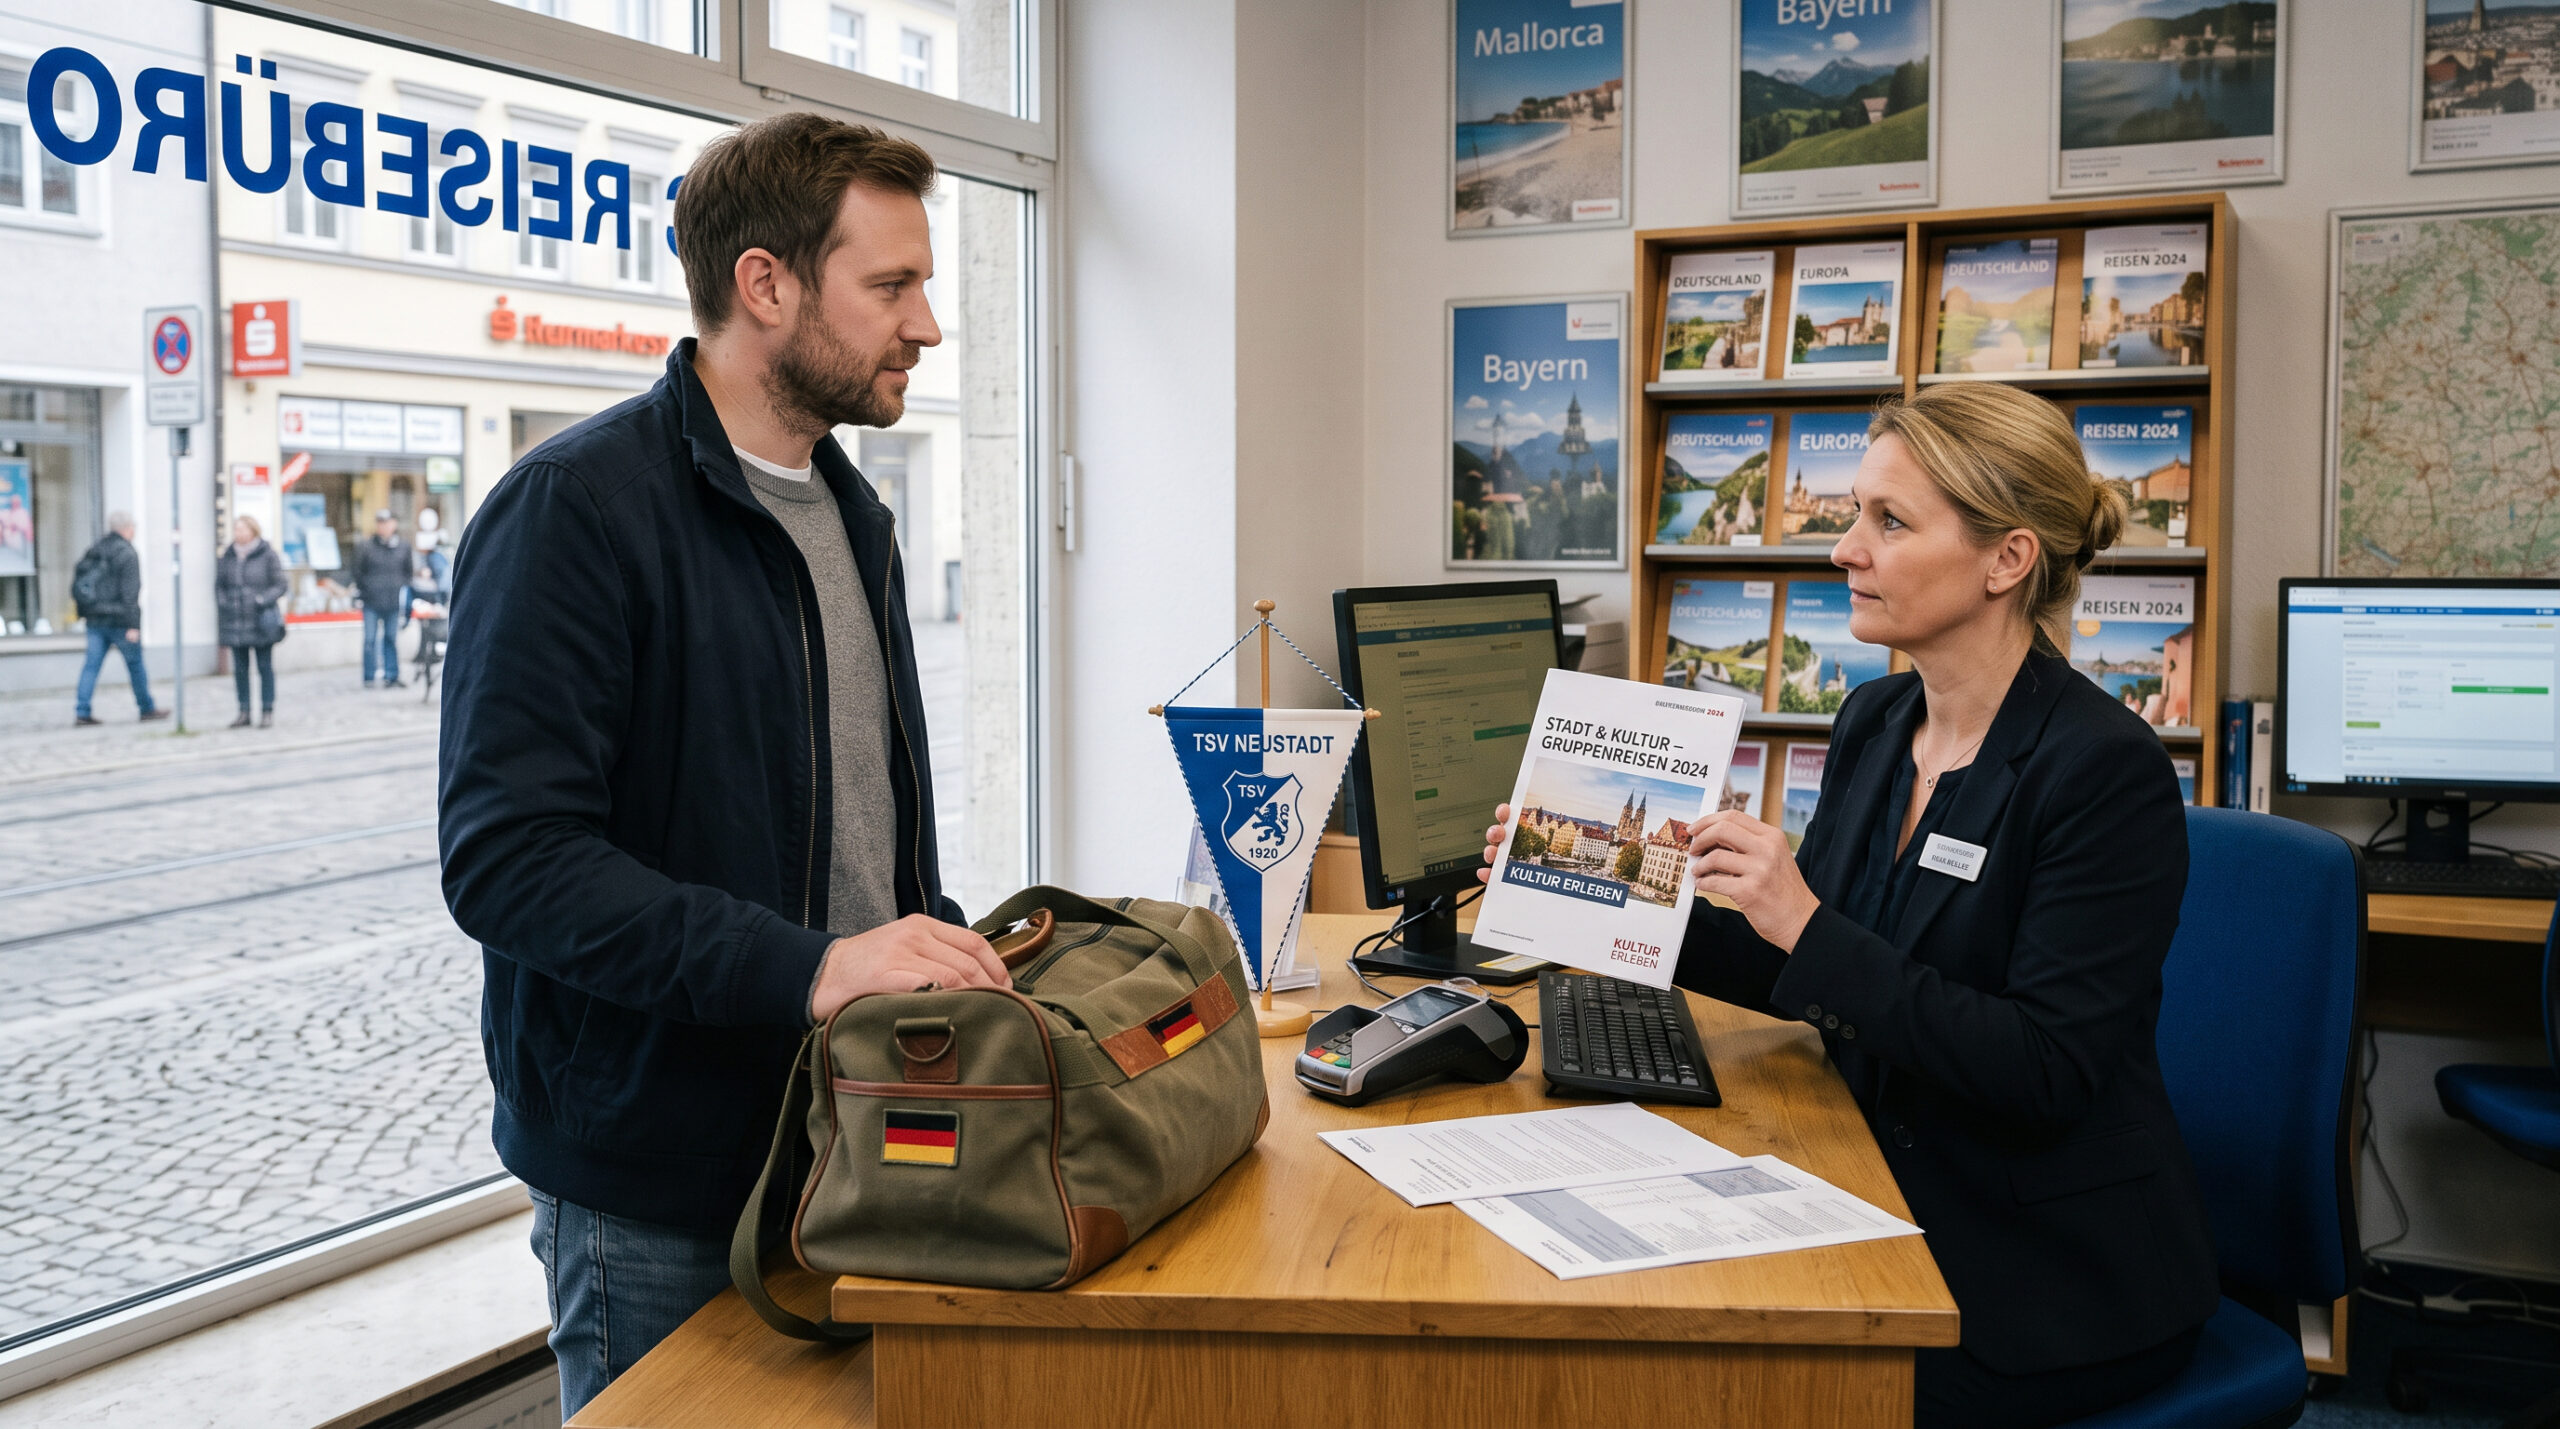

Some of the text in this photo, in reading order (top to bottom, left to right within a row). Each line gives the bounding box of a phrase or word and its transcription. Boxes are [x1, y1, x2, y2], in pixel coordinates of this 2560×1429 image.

[1474, 23, 1605, 58] Mallorca
[1950, 260, 2049, 276] DEUTSCHLAND
[2104, 253, 2187, 268] REISEN 2024
[1674, 274, 1762, 288] DEUTSCHLAND
[1800, 267, 1849, 280] EUROPA
[1482, 353, 1588, 390] Bayern
[2083, 424, 2179, 439] REISEN 2024
[1671, 433, 1764, 447] DEUTSCHLAND
[1799, 433, 1870, 450] EUROPA
[1675, 606, 1763, 620] DEUTSCHLAND
[2083, 601, 2183, 616] REISEN 2024
[1707, 708, 1725, 717] 2024
[1545, 716, 1594, 738] STADT
[1595, 725, 1608, 740] &
[1610, 728, 1671, 752] KULTUR
[1193, 733, 1334, 754] TSV NEUSTADT
[1541, 735, 1709, 779] GRUPPENREISEN 2024
[1238, 784, 1267, 797] TSV
[1249, 848, 1278, 859] 1920
[1509, 866, 1624, 903] KULTUR ERLEBEN
[1613, 938, 1662, 958] KULTUR
[1610, 950, 1659, 970] ERLEBEN
